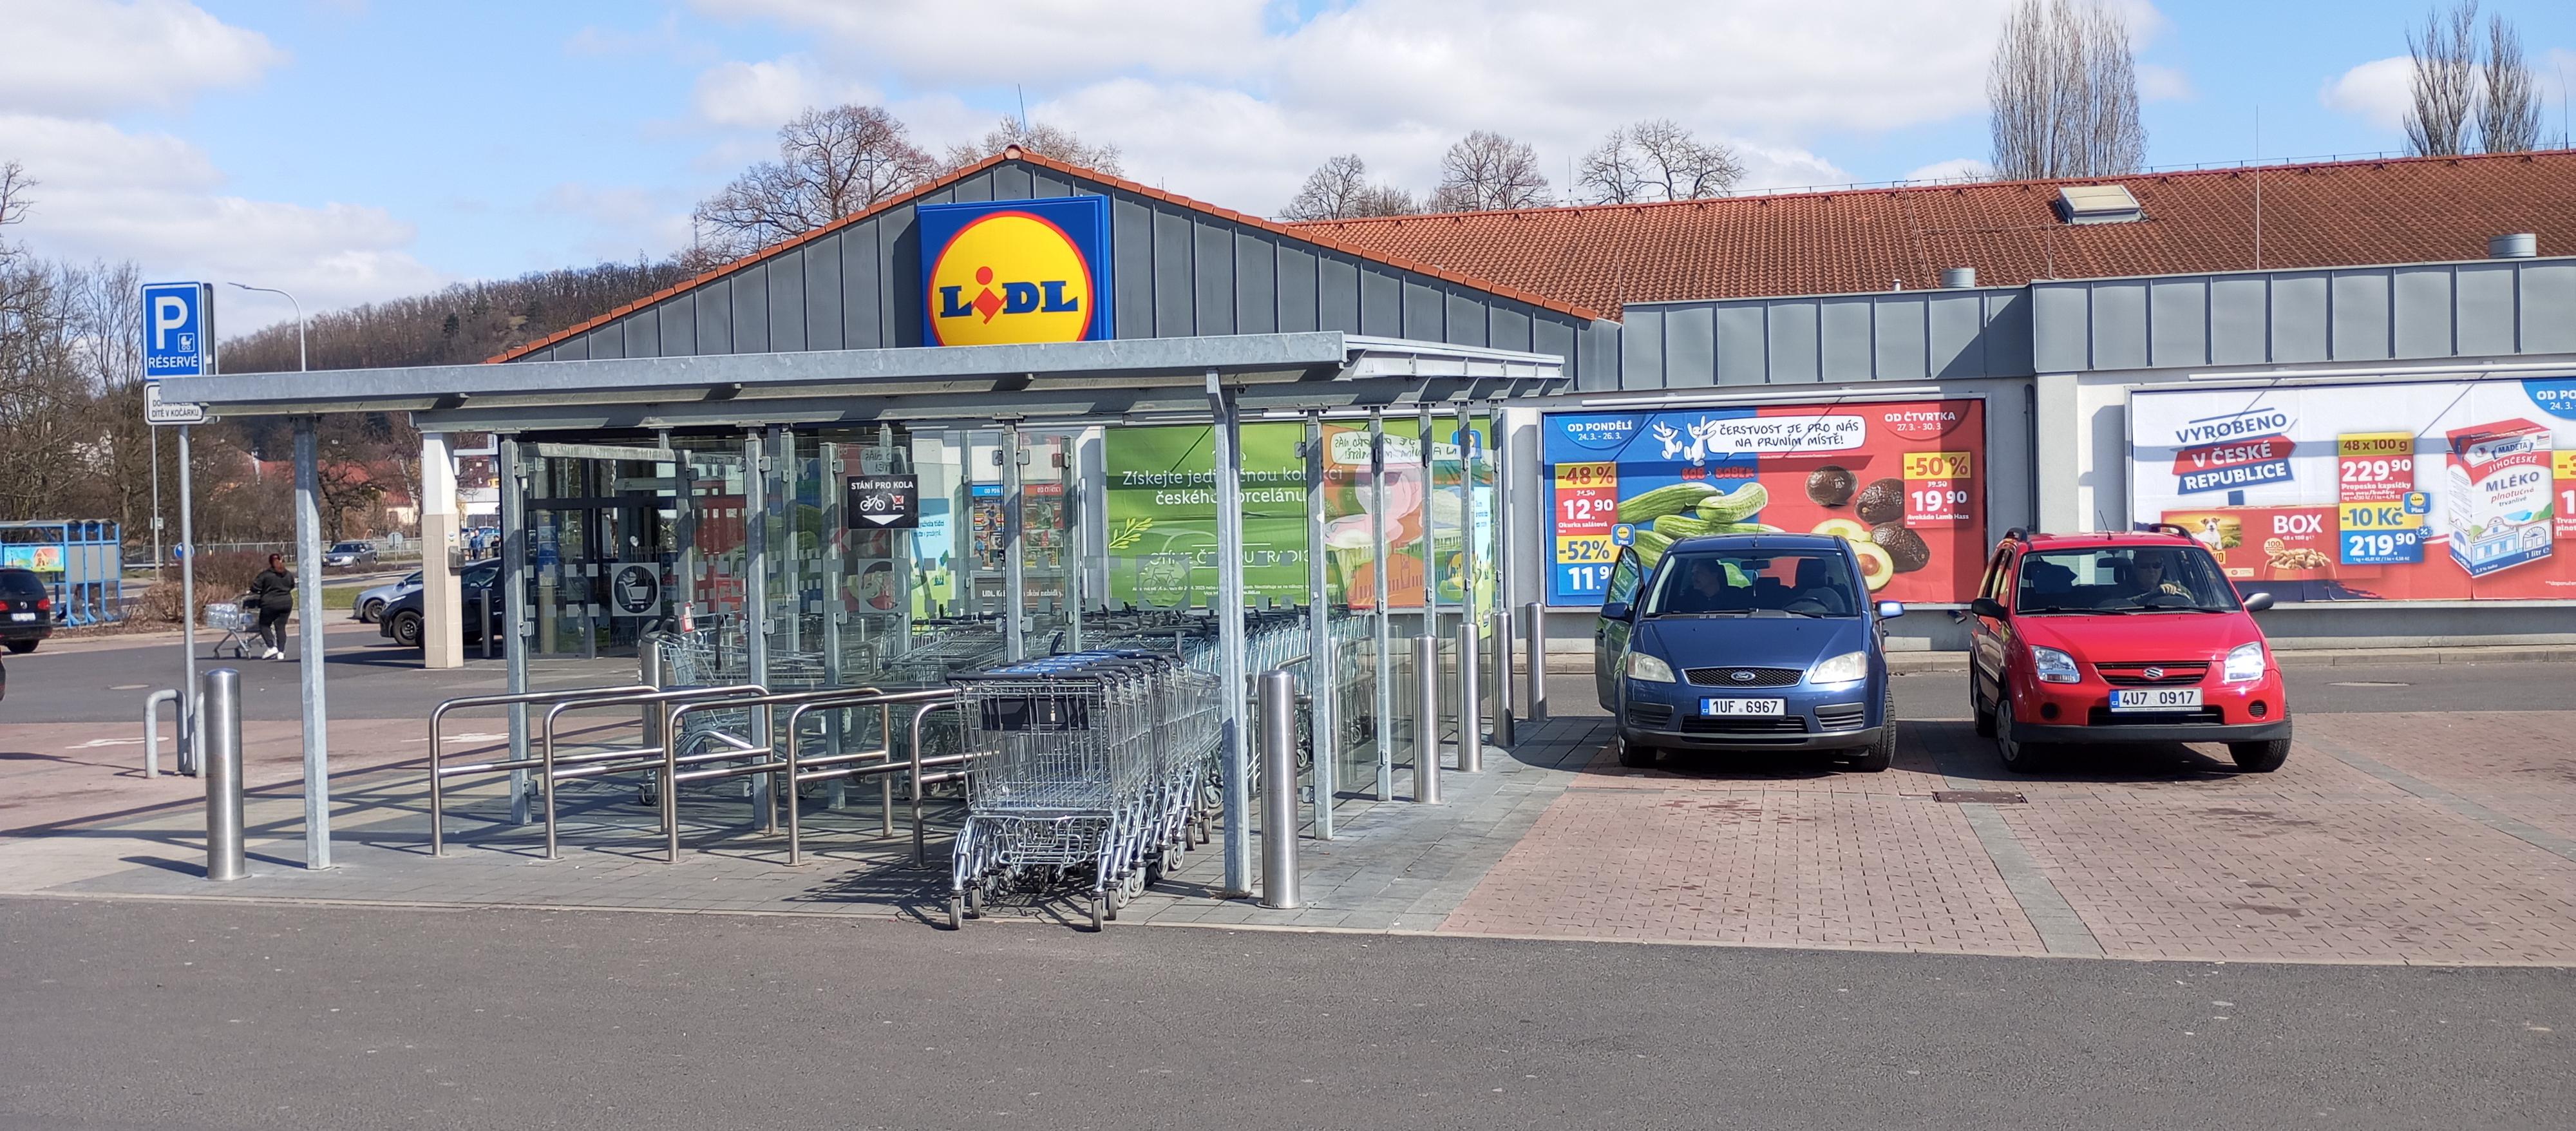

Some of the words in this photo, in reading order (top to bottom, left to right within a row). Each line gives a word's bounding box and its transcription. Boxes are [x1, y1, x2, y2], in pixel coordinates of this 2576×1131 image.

[155, 296, 188, 350] P
[148, 353, 198, 368] RÉSERVÉ
[2536, 390, 2556, 400] OD
[171, 407, 199, 417] KOČÁRKU
[1884, 413, 1902, 422] OD
[1904, 411, 1956, 422] ČTVRTKA
[1567, 423, 1584, 432] OD
[1586, 419, 1633, 432] PONDĚLÍ
[1719, 424, 1782, 435] ČERSTVOST
[1787, 424, 1803, 433] JE
[1808, 423, 1830, 433] PRO
[1836, 419, 1859, 432] NÁS
[2175, 413, 2287, 443] VYROBENO
[1735, 438, 1752, 447] NA
[1757, 434, 1801, 447] PRVNÍM
[1807, 432, 1844, 446] MÍSTĚ!
[2344, 441, 2360, 450] 48
[2374, 439, 2396, 450] 100
[2399, 441, 2407, 452] g
[2192, 453, 2206, 468] V
[2211, 440, 2272, 465] ČESKÉ
[2497, 442, 2528, 454] MADETA
[1906, 457, 1944, 476] -50
[1949, 456, 1968, 475] %
[2488, 455, 2537, 473] JIHOČESKÉ
[1122, 470, 1182, 488] Získejte
[1557, 467, 1591, 485] -48
[1596, 466, 1614, 484] %
[2184, 462, 2287, 490] REPUBLICE
[2486, 471, 2540, 492] MLÉKO
[851, 480, 873, 490] STÁNÍ
[1156, 489, 1217, 505] českého
[1239, 488, 1307, 503] orcelánu
[2490, 488, 2535, 503] plnotučné
[2499, 496, 2527, 507] trvanlivé
[2273, 514, 2323, 534] BOX
[2342, 508, 2372, 526] -10
[2378, 507, 2403, 526] Kč
[2122, 692, 2148, 705] 4U7
[2159, 690, 2194, 705] 0917
[1712, 700, 1735, 713] 1UF
[1746, 700, 1777, 713] 6967
